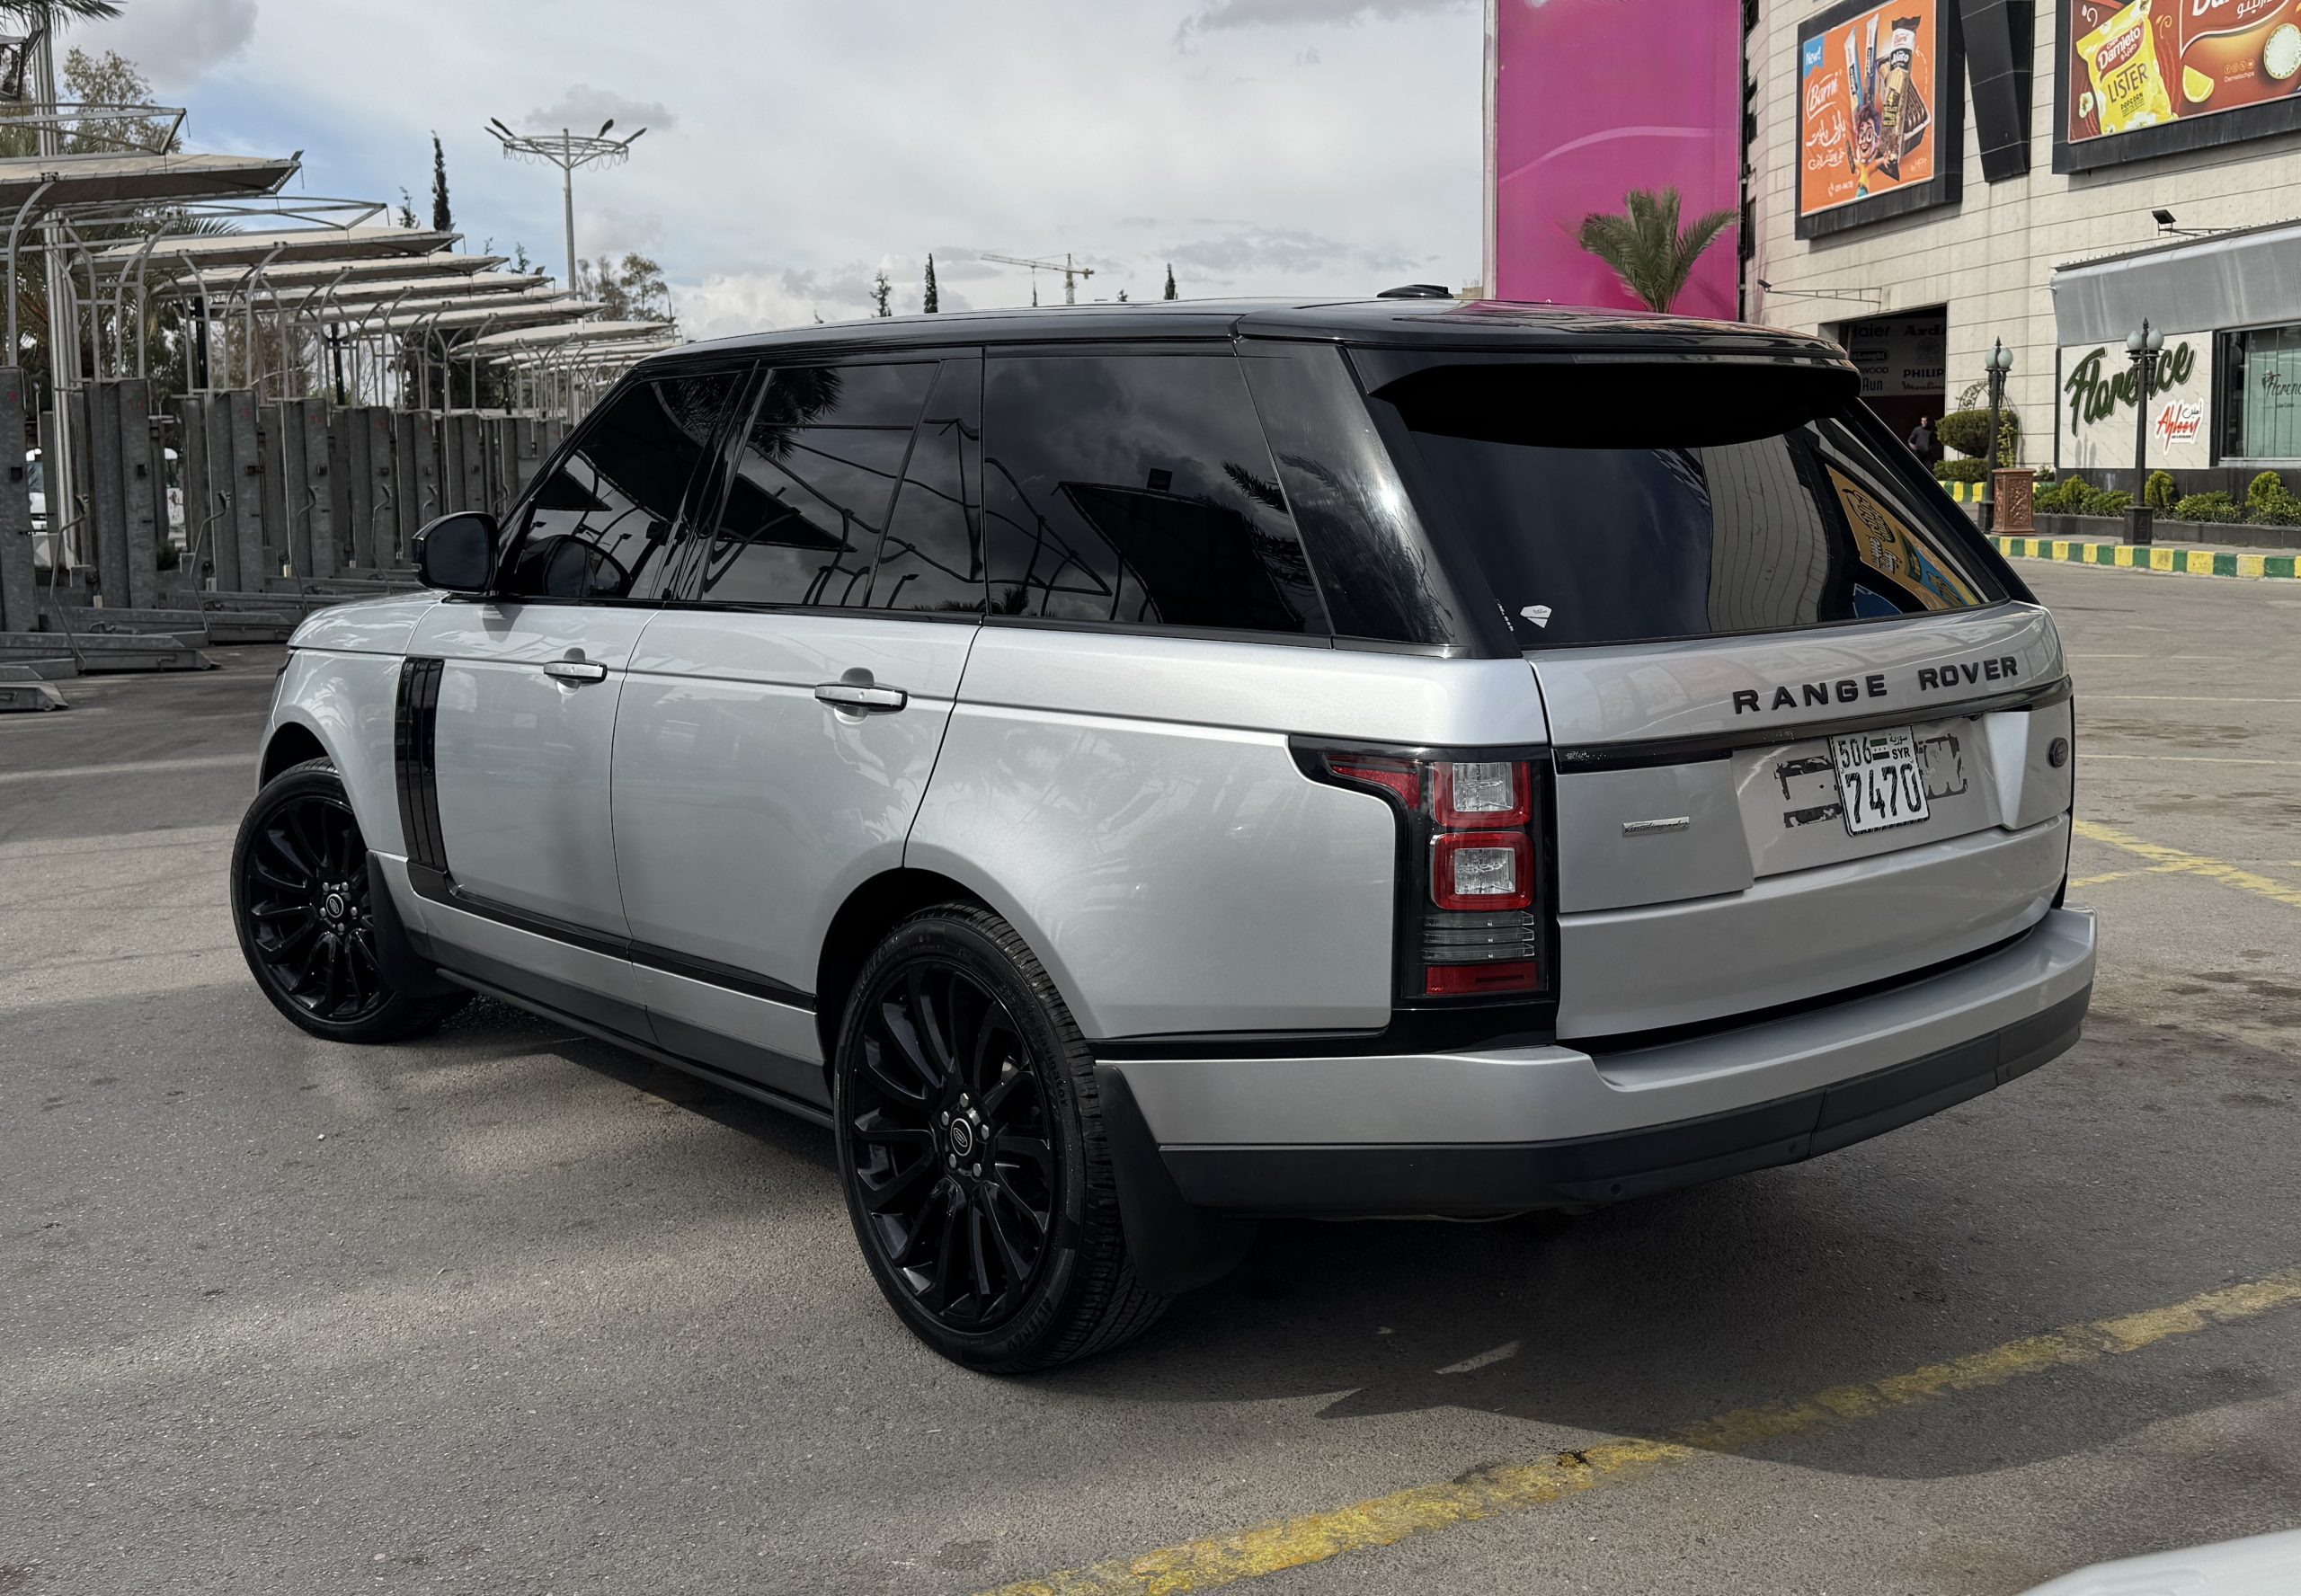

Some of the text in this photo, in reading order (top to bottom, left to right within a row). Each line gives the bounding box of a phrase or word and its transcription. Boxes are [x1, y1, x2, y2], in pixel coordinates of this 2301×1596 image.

[1806, 46, 1821, 66] New!
[2108, 63, 2148, 103] LISTER
[1733, 656, 2019, 714] RANGE ROVER
[1838, 737, 1872, 768] 506
[1892, 747, 1910, 759] SYR
[1845, 763, 1922, 824] 7470
